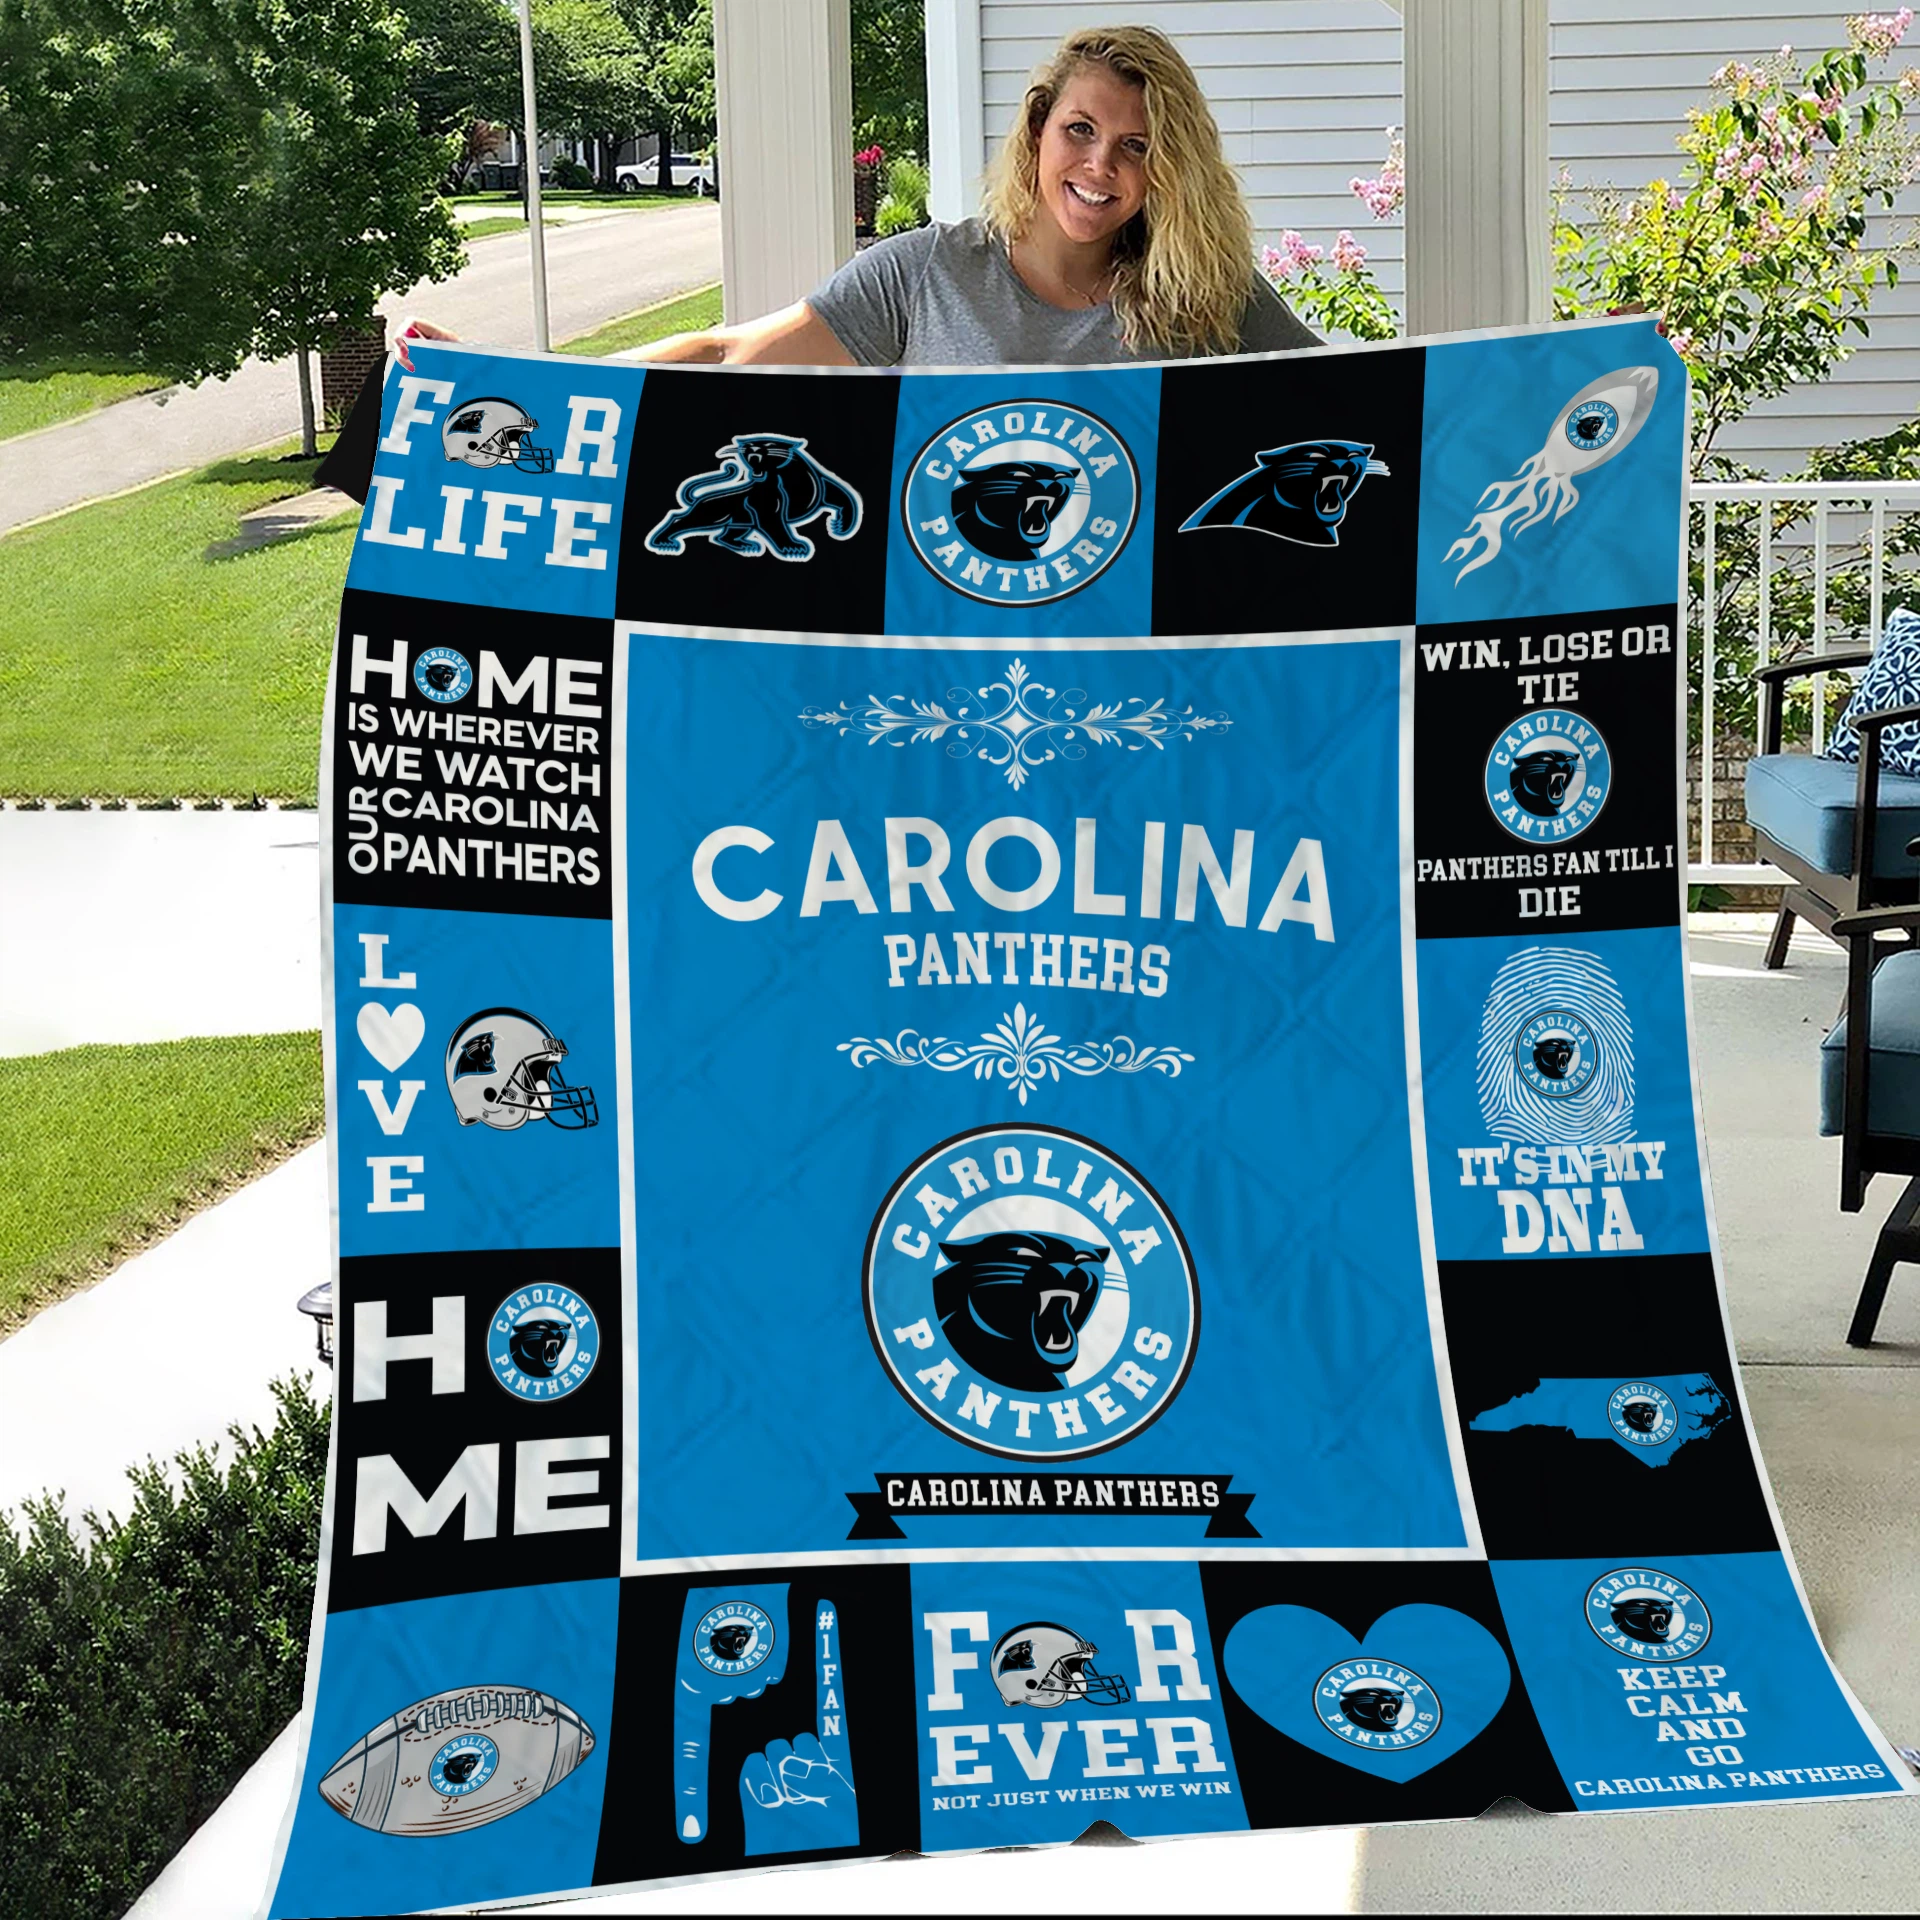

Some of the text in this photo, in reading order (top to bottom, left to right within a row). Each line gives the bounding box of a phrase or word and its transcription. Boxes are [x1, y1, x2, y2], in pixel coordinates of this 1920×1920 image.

[925, 411, 1120, 482] CAROLINA
[362, 478, 612, 571] LIFE
[920, 514, 1118, 593] PANTHERS
[418, 649, 468, 673] CAROLINA
[1420, 624, 1671, 672] WIN, LOSE OR
[417, 677, 468, 701] PANTHERS
[1517, 671, 1579, 705] TIE
[348, 701, 599, 754] IS WHEREVER
[1494, 715, 1601, 767] CAROLINA
[348, 740, 601, 796] WE WATCH
[382, 787, 600, 833] CAROLINA
[1493, 784, 1602, 837] PANTHERS
[348, 787, 378, 875] OUR
[383, 832, 601, 886] PANTHERS
[1417, 844, 1674, 883] PANTHERS FAN TILL I
[692, 815, 1336, 943] CAROLINA
[1518, 886, 1581, 918] DIE
[883, 931, 1171, 998] PANTHERS
[1522, 1016, 1589, 1048] CAROLINA
[1523, 1060, 1591, 1092] PANTHERS
[892, 1146, 1162, 1265] CAROLINA
[1497, 1186, 1645, 1254] DNA
[495, 1288, 591, 1333] CAROLINA
[494, 1349, 592, 1396] PANTHERS
[893, 1317, 1173, 1439] PANTHERS
[1612, 1385, 1668, 1409] CAROLINA
[1615, 1418, 1673, 1442] PANTHERS
[887, 1479, 1220, 1508] CAROLINA PANTHERS
[1593, 1573, 1692, 1609] CAROLINA
[701, 1605, 767, 1634] CAROLINA
[700, 1643, 768, 1671] PANTHERS
[1600, 1622, 1704, 1657] PANTHERS
[1321, 1663, 1424, 1698] CAROLINA
[1617, 1664, 1727, 1691] KEEP
[1626, 1691, 1748, 1717] CALM
[1327, 1712, 1434, 1746] PANTHERS
[1656, 1717, 1747, 1742] AND
[436, 1737, 493, 1763] CAROLINA
[929, 1716, 1227, 1787] EVER
[1685, 1745, 1744, 1767] GO
[433, 1767, 492, 1793] PANTHERS
[932, 1781, 1232, 1811] NOT JUST WHEN WE WIN
[1574, 1763, 1885, 1797] CAROLINA PANTHERS
